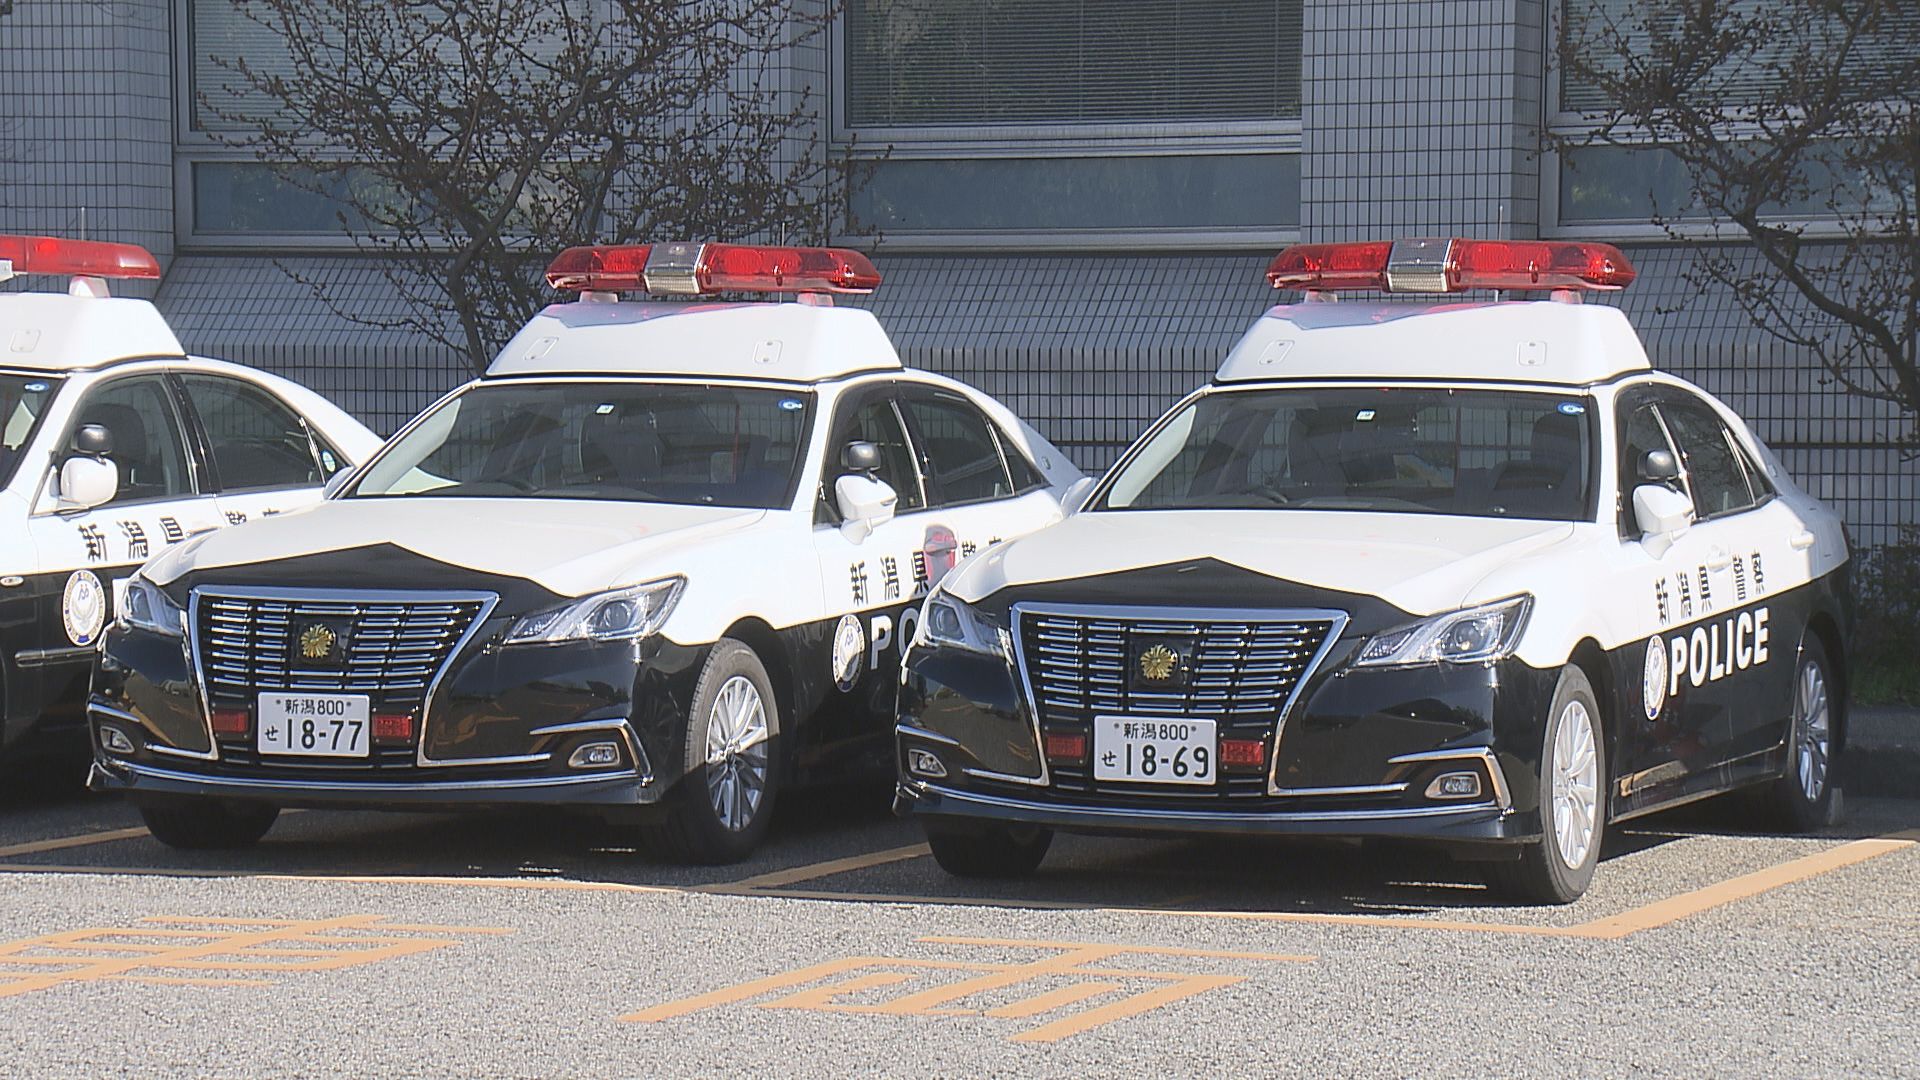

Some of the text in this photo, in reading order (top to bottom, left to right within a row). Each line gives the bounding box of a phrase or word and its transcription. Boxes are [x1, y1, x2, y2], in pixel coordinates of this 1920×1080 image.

[78, 508, 280, 562] 新潟県
[850, 536, 1002, 606] 新潟県
[1669, 607, 1769, 697] POLICE
[287, 718, 364, 751] 18-77
[1125, 743, 1210, 778] 18-69
